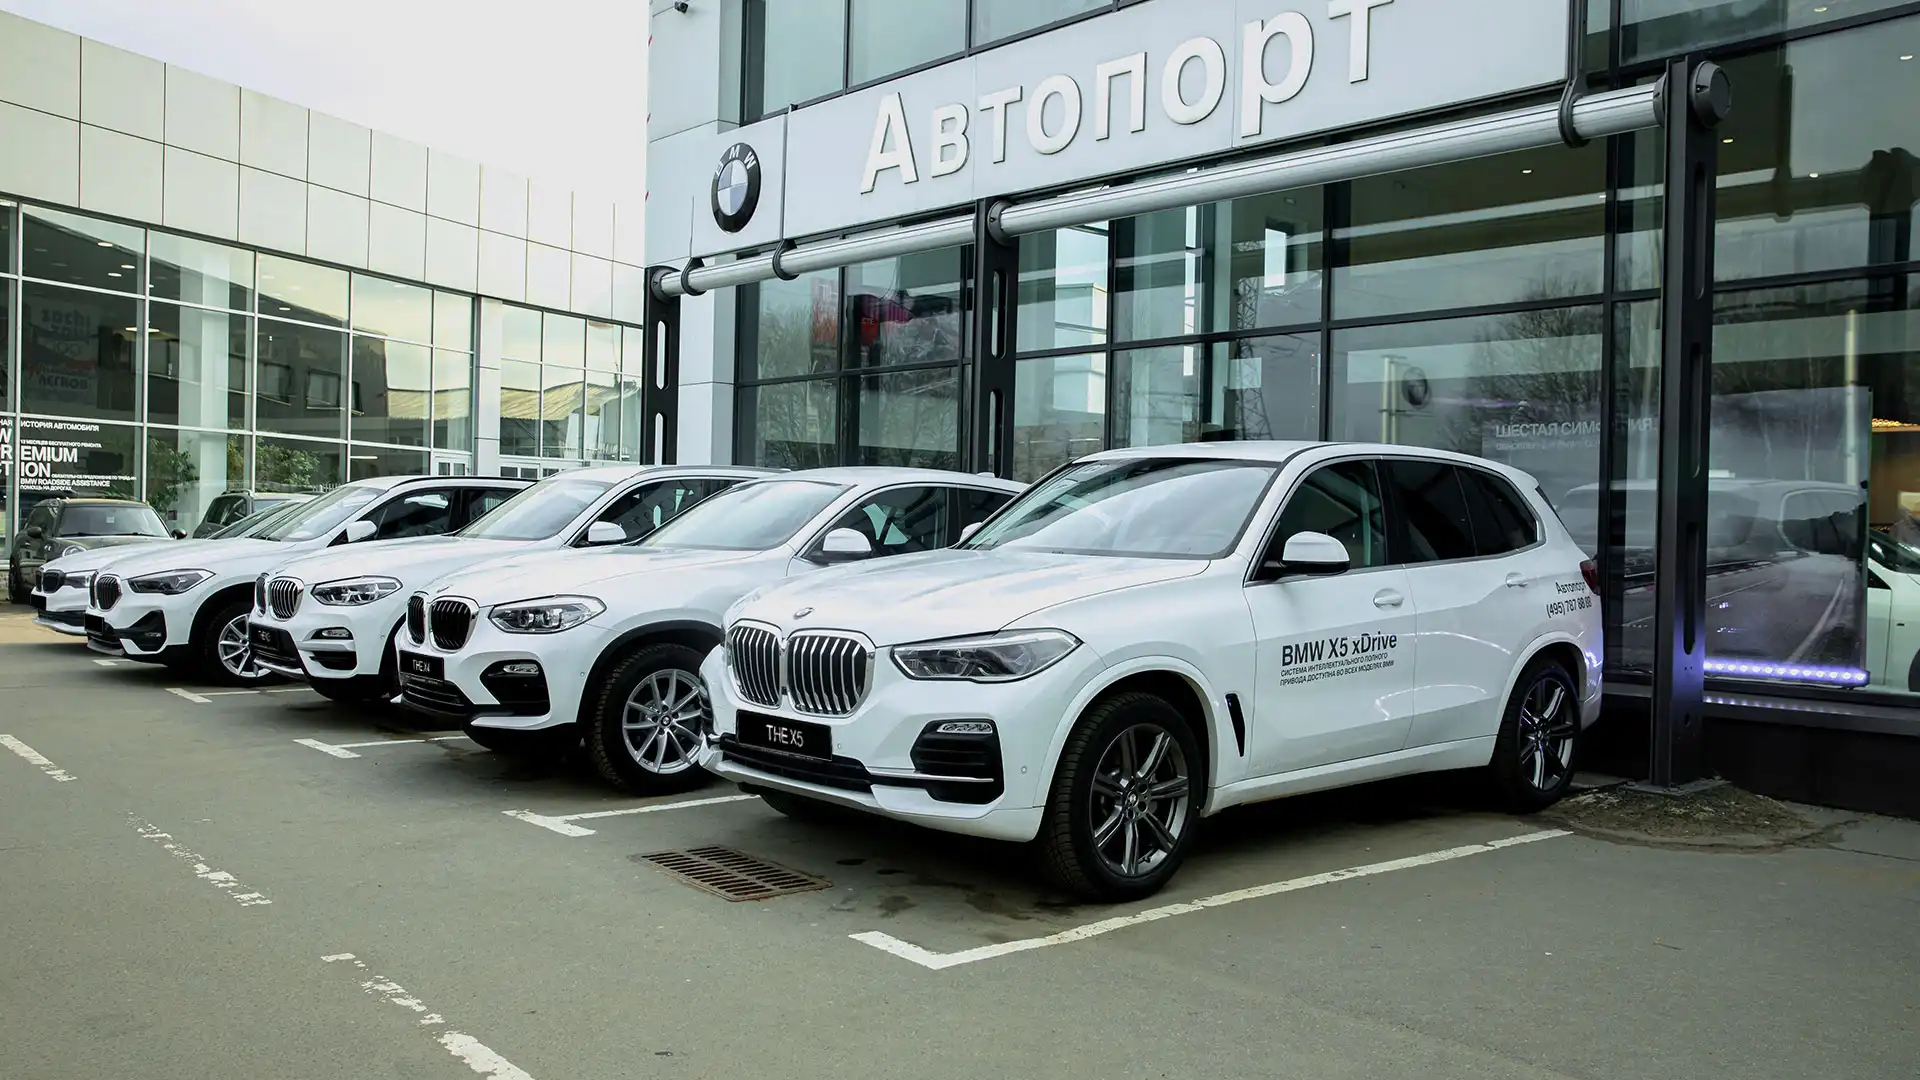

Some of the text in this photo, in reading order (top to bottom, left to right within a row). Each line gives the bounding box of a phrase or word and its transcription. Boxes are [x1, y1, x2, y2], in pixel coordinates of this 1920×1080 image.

[860, 0, 1392, 194] Автопорт
[716, 145, 757, 177] BMW
[20, 420, 53, 430] ИСТОРИЯ
[54, 422, 100, 432] АВТОМОБИЛЯ
[1496, 423, 1559, 438] ШЕСТАЯ
[38, 478, 71, 487] ROADSIDE
[71, 479, 111, 488] ASSISTANCE
[1546, 601, 1565, 619] (495)
[1565, 599, 1577, 612] 787
[1282, 631, 1397, 666] BMW X5 xDrive
[1280, 675, 1307, 687] ПРИВОДА
[1307, 671, 1336, 683] ДОСТУПНА
[1336, 669, 1344, 678] ВО
[1345, 665, 1358, 675] ВСЕХ
[1358, 662, 1382, 673] МОДЕЛЯХ
[1281, 652, 1388, 678] СИСТЕМА ИНТЕЛЛЕКТУАЛЬНОГО ПОЛНОГО
[766, 724, 804, 748] THE X5
